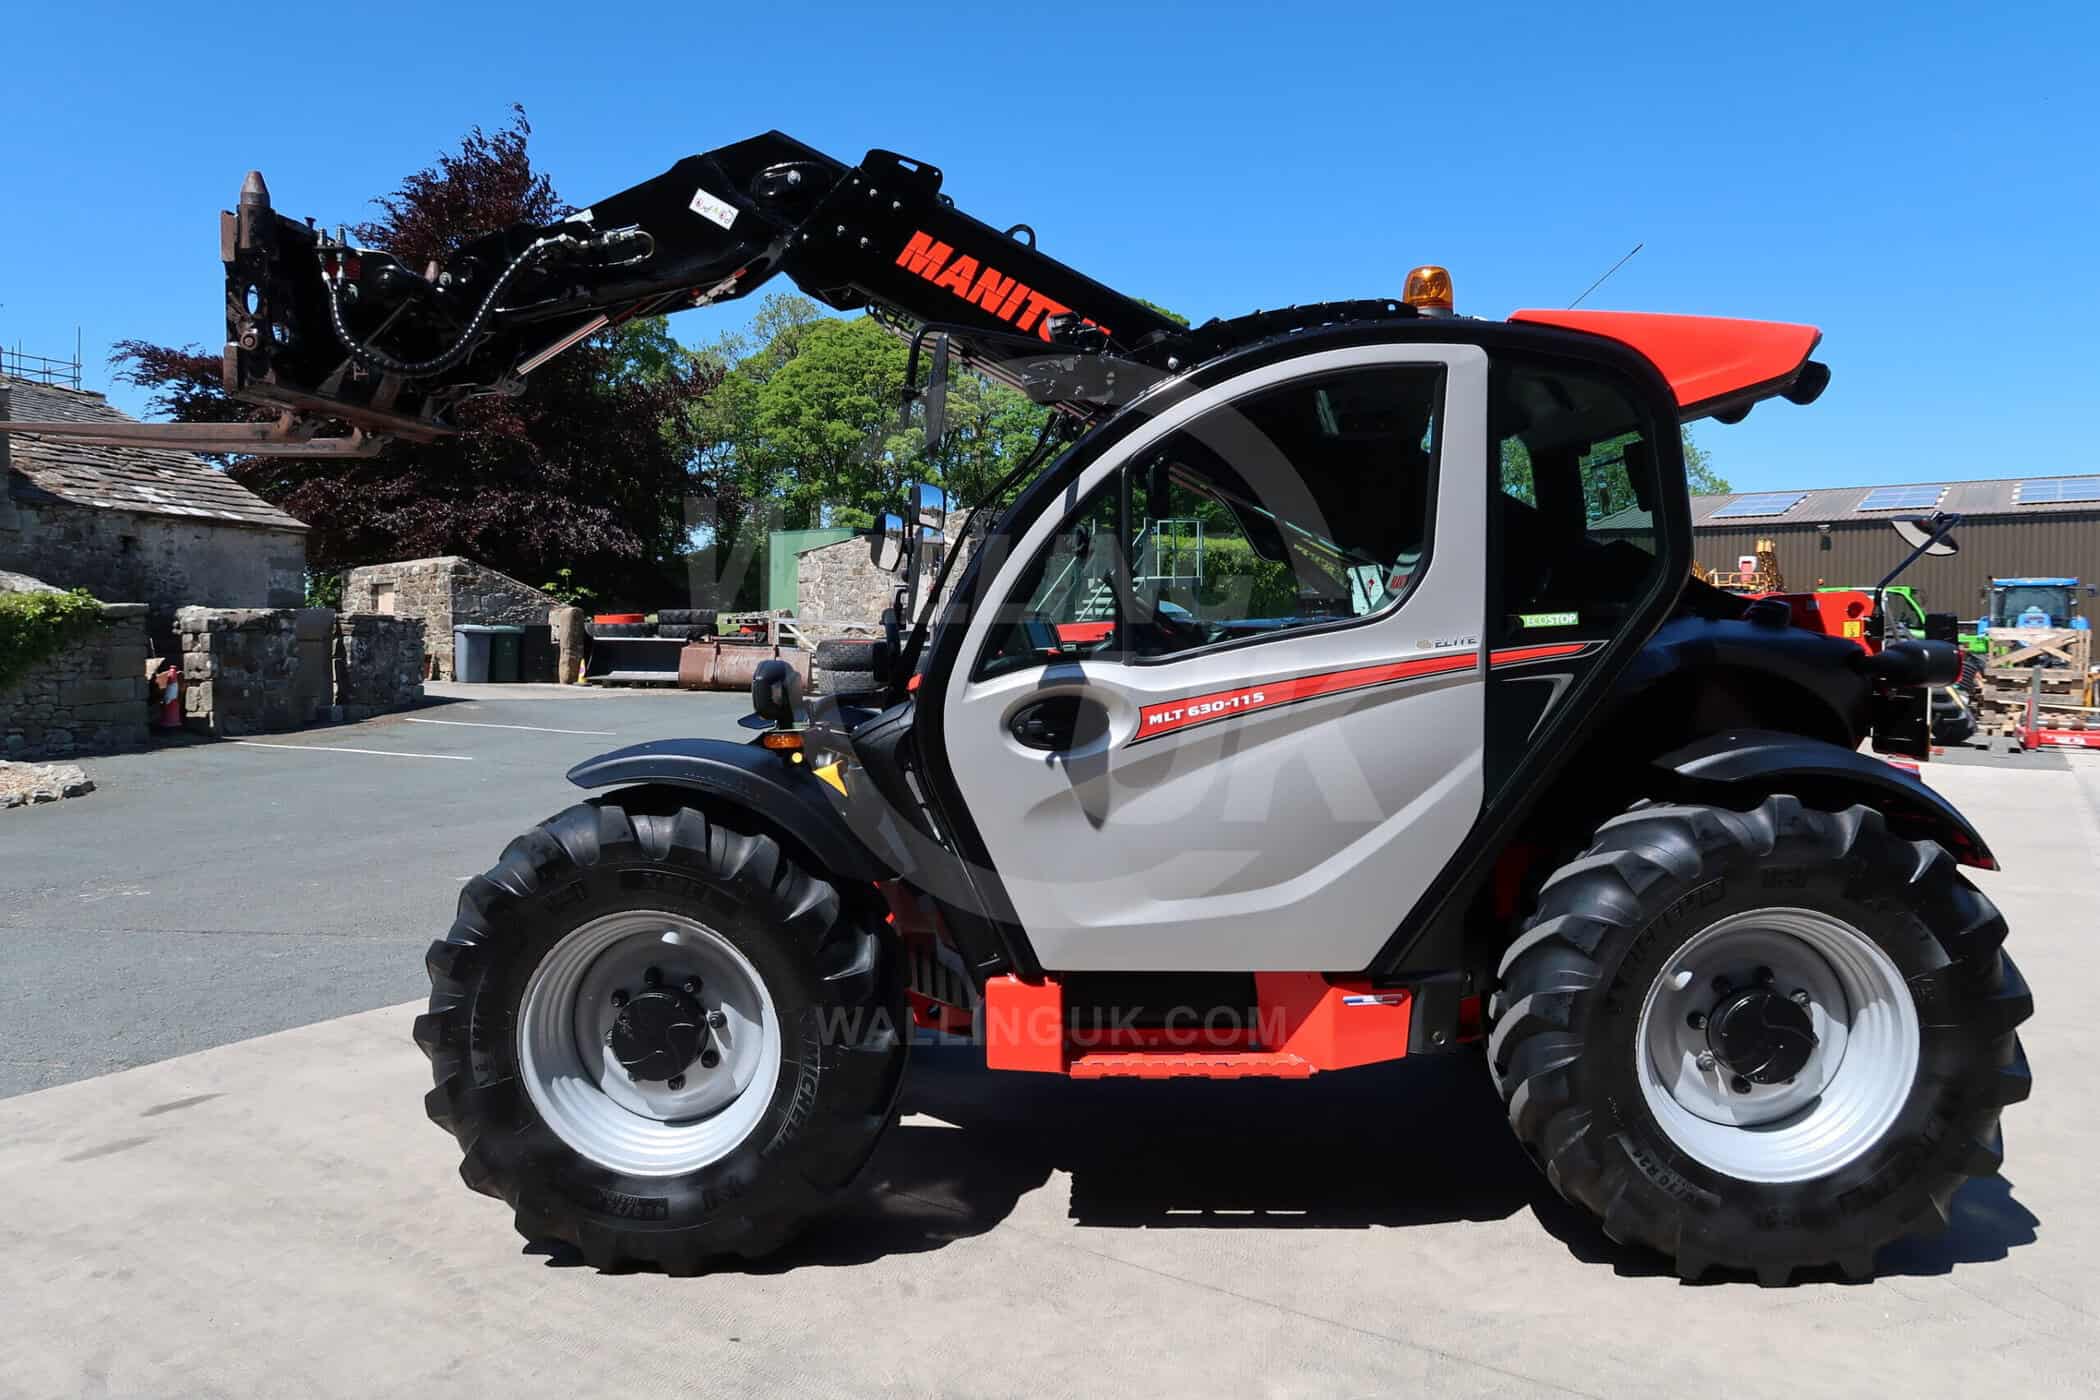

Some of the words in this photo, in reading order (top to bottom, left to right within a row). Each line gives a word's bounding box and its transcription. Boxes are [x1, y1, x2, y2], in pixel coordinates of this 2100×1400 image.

[1526, 612, 1577, 626] ECOSTOP
[1148, 709, 1185, 725] MLT
[1187, 692, 1265, 717] 630-115
